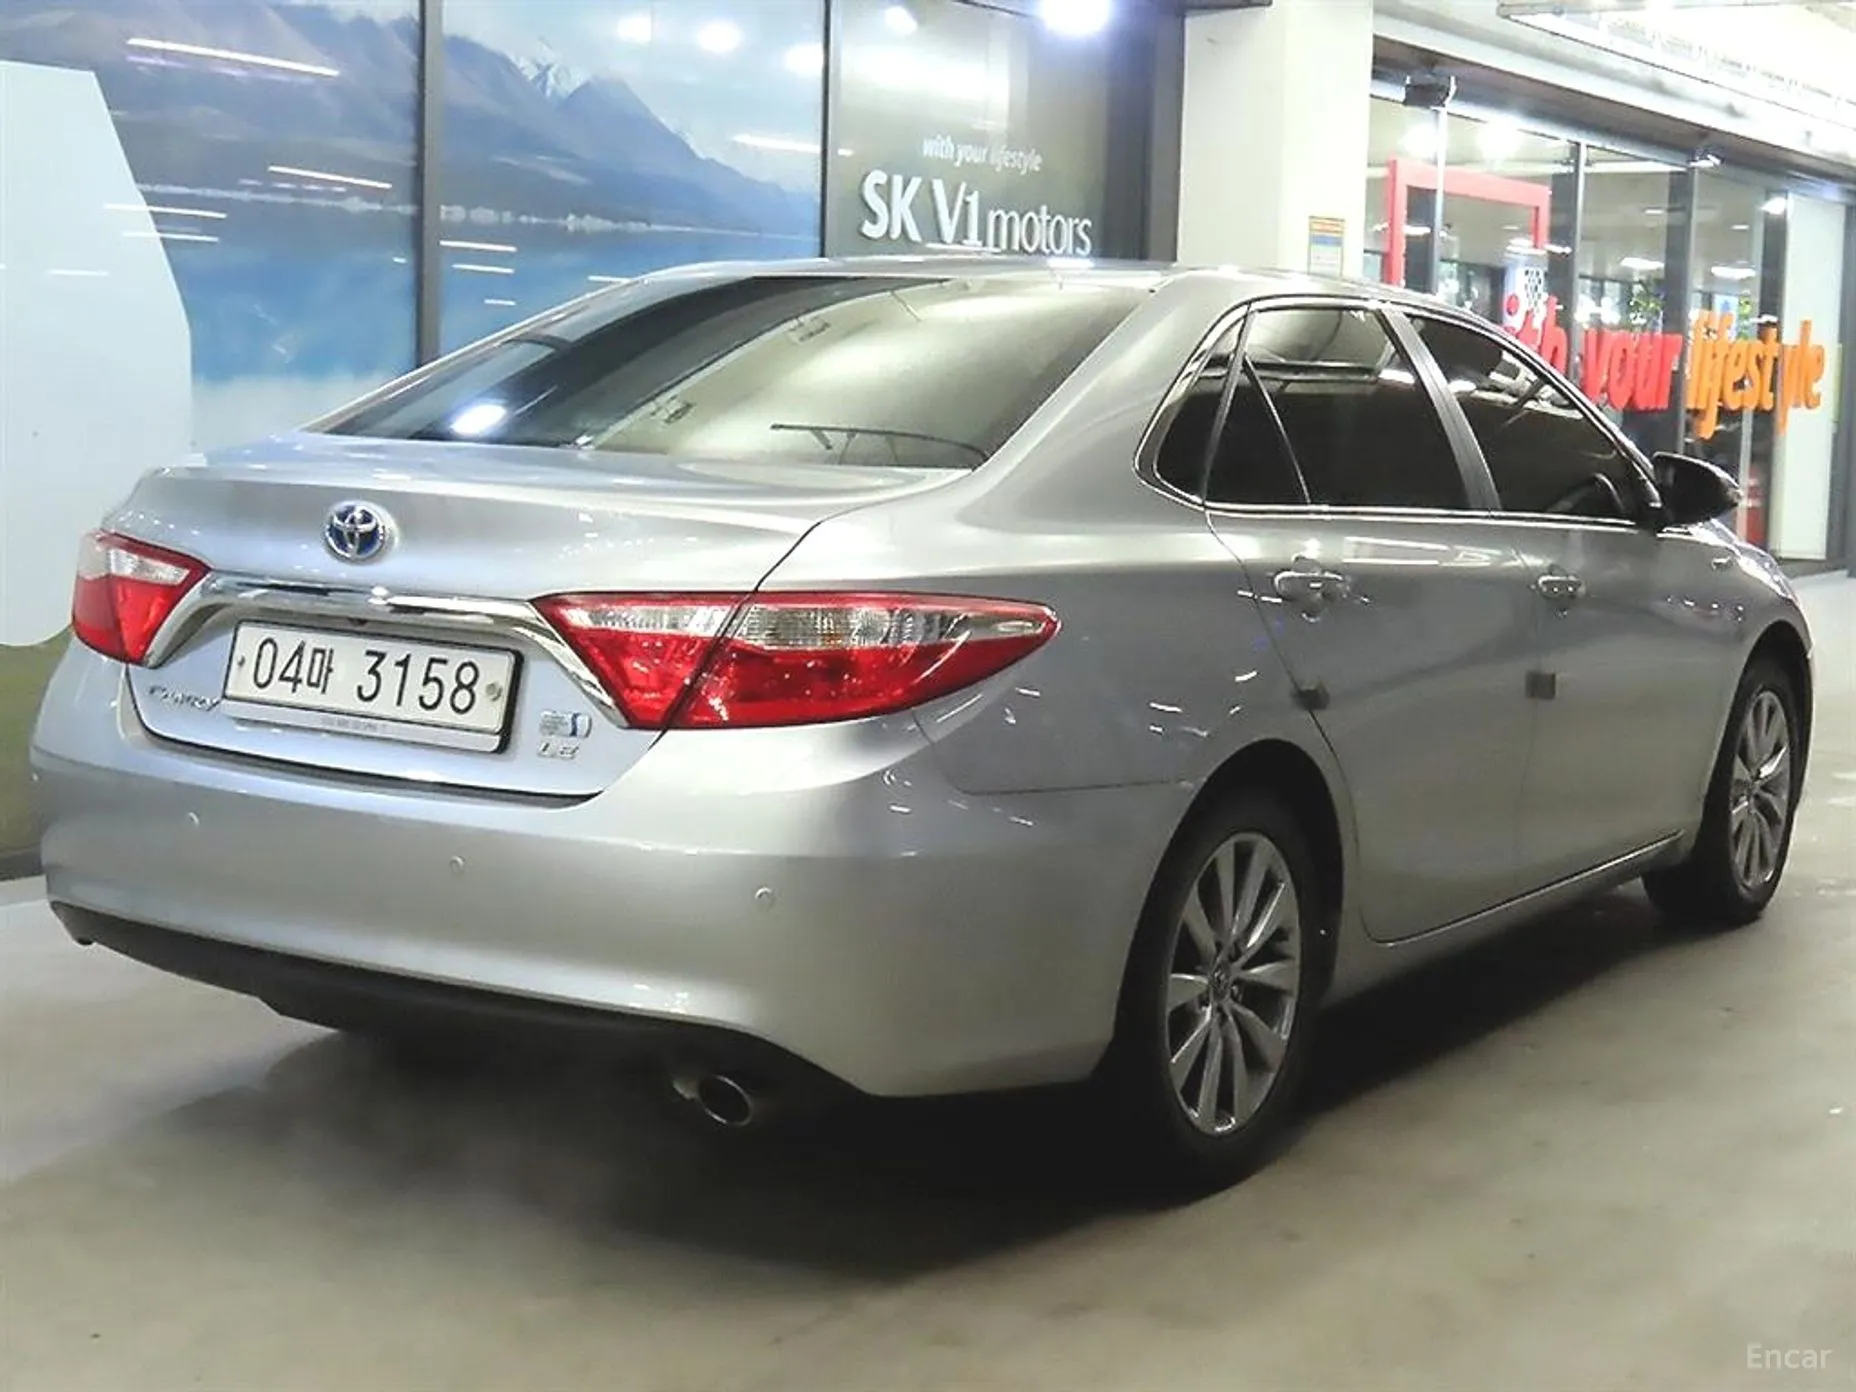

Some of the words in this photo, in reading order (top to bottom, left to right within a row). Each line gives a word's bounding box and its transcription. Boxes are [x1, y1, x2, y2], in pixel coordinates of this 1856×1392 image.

[922, 134, 955, 160] with
[954, 144, 988, 168] your
[989, 144, 1043, 175] lifestyle
[860, 169, 923, 243] SK
[985, 203, 1093, 257] motors
[1583, 327, 1683, 411] your
[1684, 310, 1826, 440] lifestyle
[252, 636, 335, 695] 04마
[356, 649, 481, 715] 3158
